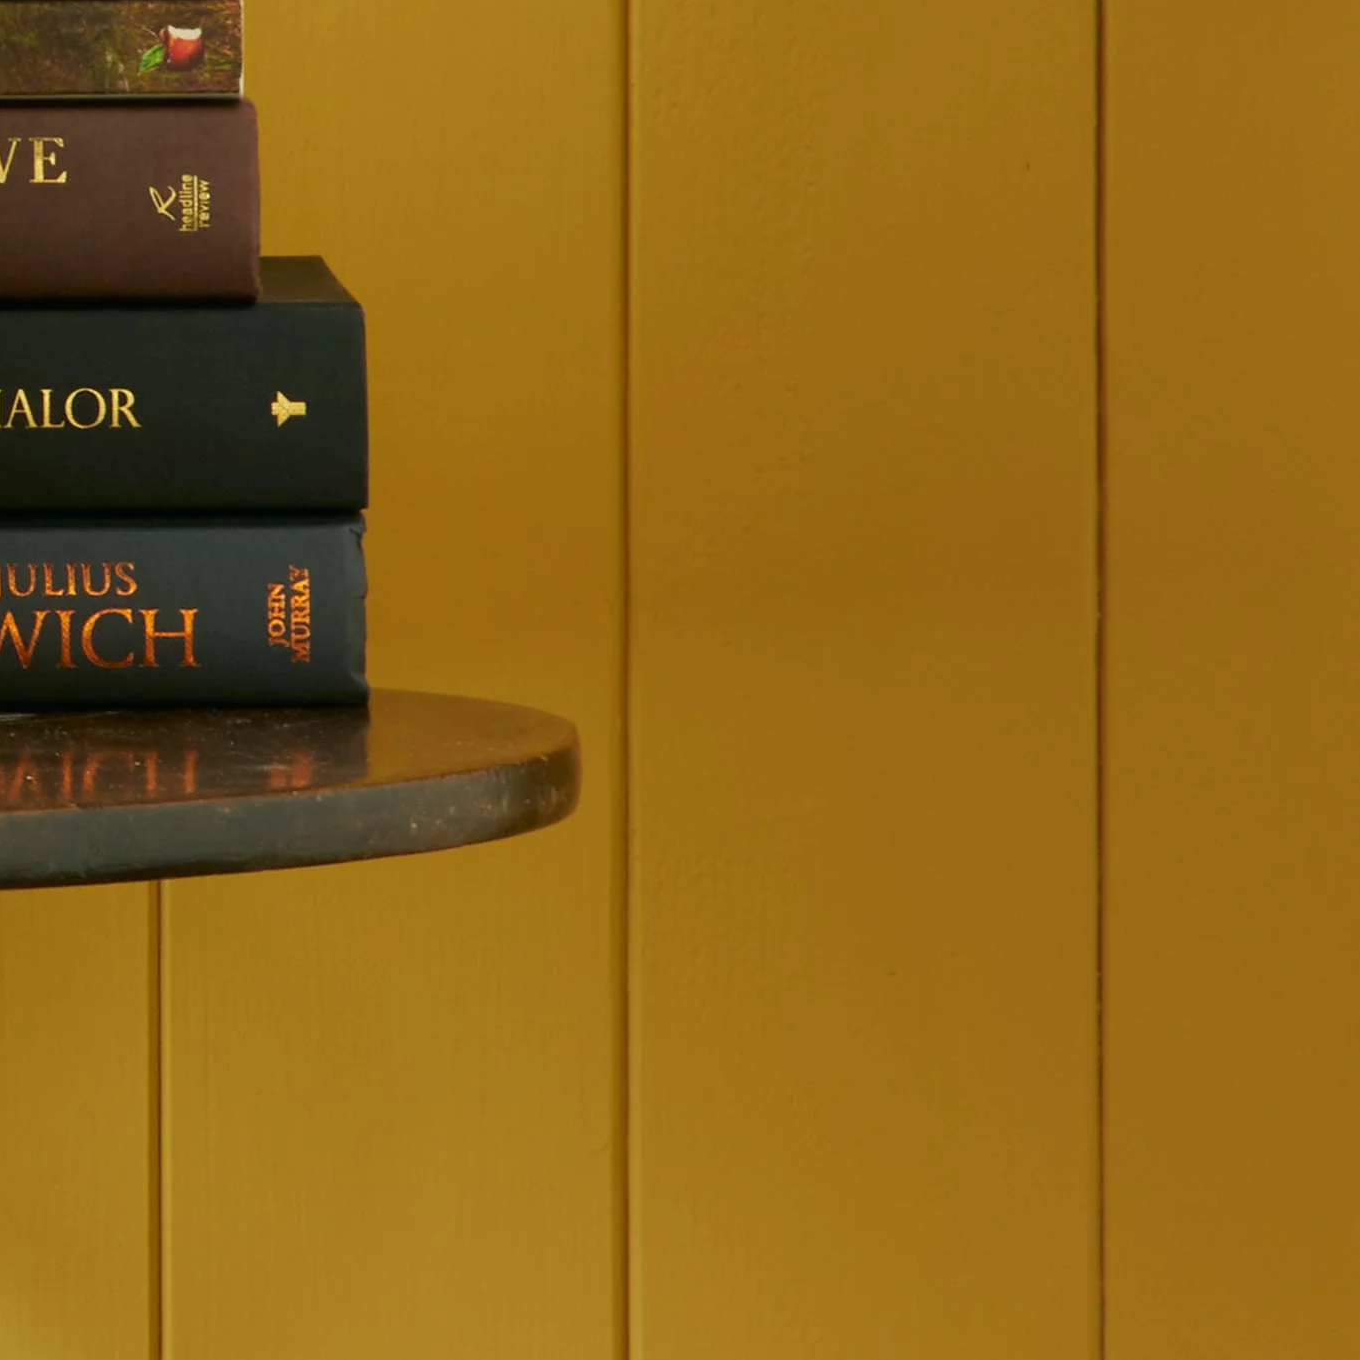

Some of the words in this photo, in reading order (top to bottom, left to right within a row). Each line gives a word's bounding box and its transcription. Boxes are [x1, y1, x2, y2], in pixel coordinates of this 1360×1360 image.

[179, 174, 193, 232] headline
[199, 179, 211, 228] review
[267, 582, 291, 648] JOHN
[289, 564, 311, 663] MURRAY
